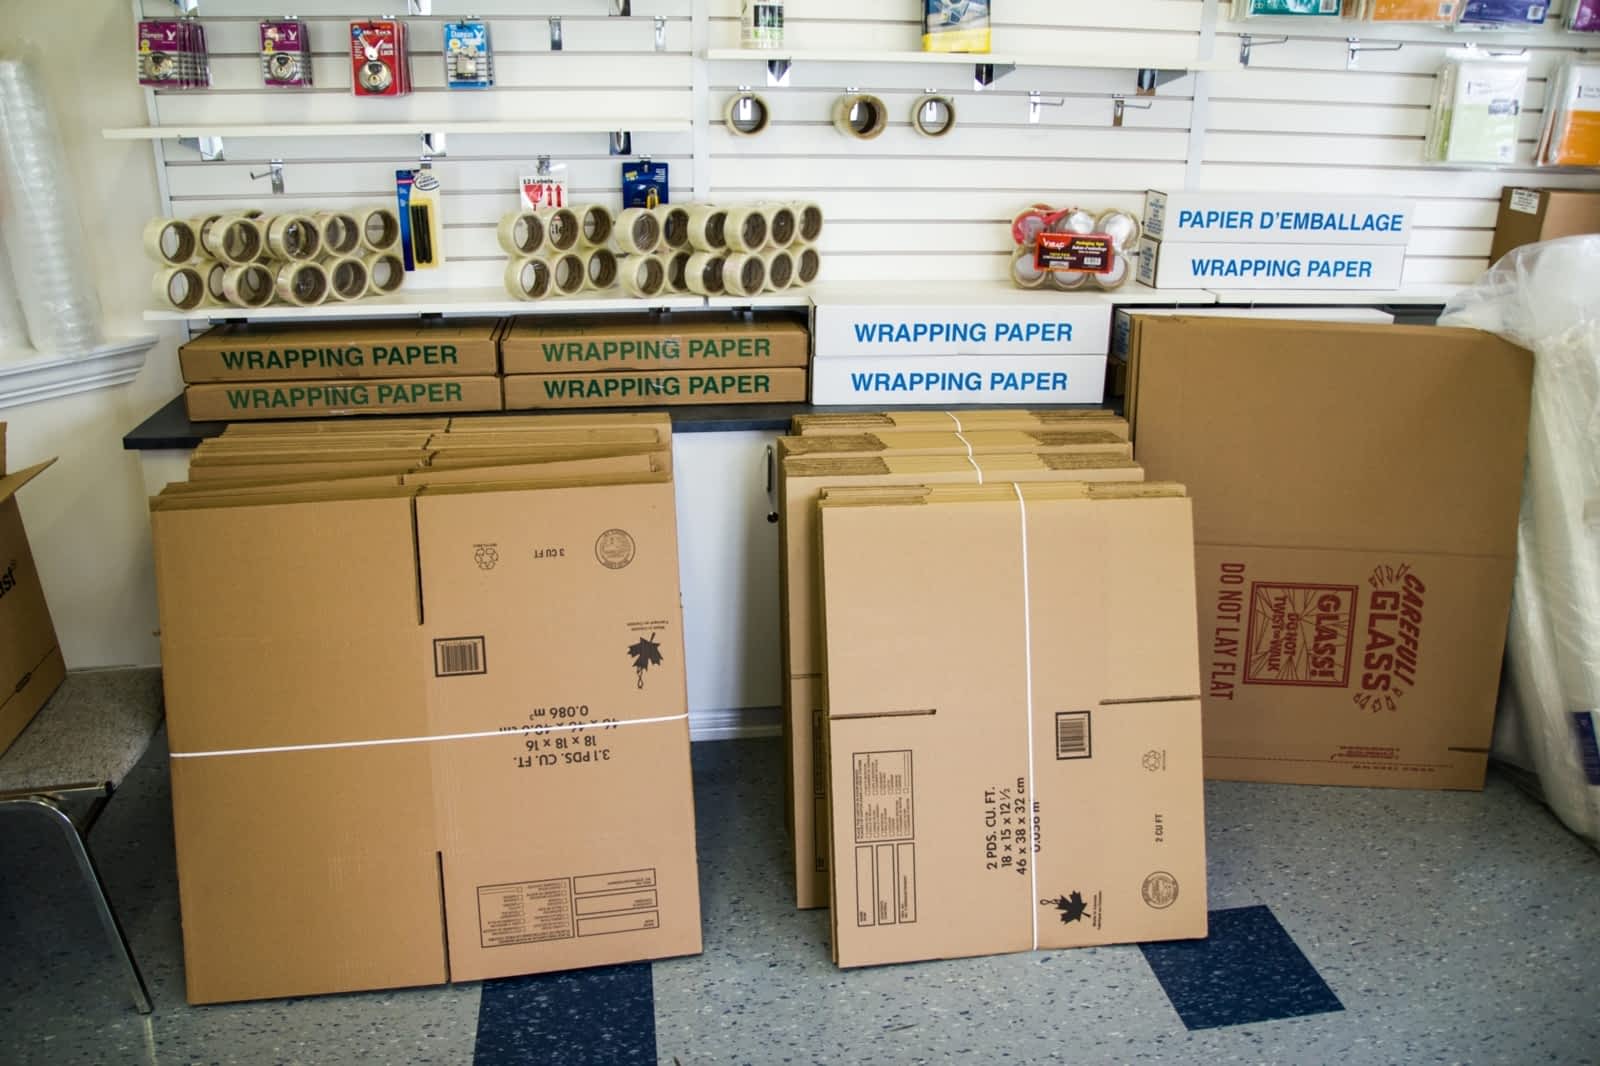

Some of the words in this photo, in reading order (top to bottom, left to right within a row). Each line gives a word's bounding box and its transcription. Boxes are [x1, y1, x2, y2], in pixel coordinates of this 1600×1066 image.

[1179, 211, 1253, 229] PAPIER
[1260, 212, 1404, 231] D'EMBALLAGE
[1191, 259, 1301, 277] WRAPPING
[1307, 261, 1372, 277] PAPER
[854, 323, 986, 342] WRAPPING
[995, 323, 1073, 342] PAPER
[221, 347, 363, 369] WRAPPING
[372, 345, 458, 365] PAPER
[541, 341, 680, 362] WRAPPING
[688, 338, 770, 357] PAPER
[543, 377, 680, 398] WRAPPING
[688, 374, 770, 394] PAPER
[851, 372, 982, 391] WRAPPING
[990, 372, 1068, 390] PAPER
[226, 387, 368, 409] WRAPPING
[377, 383, 463, 403] PAPER
[534, 550, 543, 558] FT
[545, 549, 557, 558] CU
[559, 549, 565, 557] 3
[1219, 563, 1245, 584] DO
[1216, 590, 1243, 623] NOT
[1271, 595, 1290, 631] TWIST
[1286, 613, 1299, 630] DO
[1309, 594, 1342, 677] GLASS!
[1393, 574, 1426, 687] CAREFUL!
[1213, 627, 1240, 655] LAY
[1283, 633, 1297, 656] NOT
[1361, 590, 1400, 691] GLASS
[1210, 660, 1237, 700] FLAT
[549, 705, 589, 719] 0.086
[526, 739, 539, 751] 16
[555, 737, 568, 749] 18
[584, 735, 597, 747] 18
[513, 756, 532, 768] FT.
[536, 753, 557, 766] CU.
[561, 751, 590, 764] PDS.
[593, 748, 610, 761] 3.1
[1017, 777, 1024, 794] cm
[985, 786, 995, 804] FT.
[1015, 797, 1025, 814] 32
[985, 806, 996, 828] CU.
[1155, 814, 1162, 823] FT
[1001, 828, 1011, 840] 15
[1015, 828, 1026, 843] 38
[1155, 824, 1163, 835] CU
[986, 831, 997, 859] PDS.
[987, 861, 997, 870] 2
[1001, 855, 1012, 868] 18
[1016, 858, 1027, 875] 46
